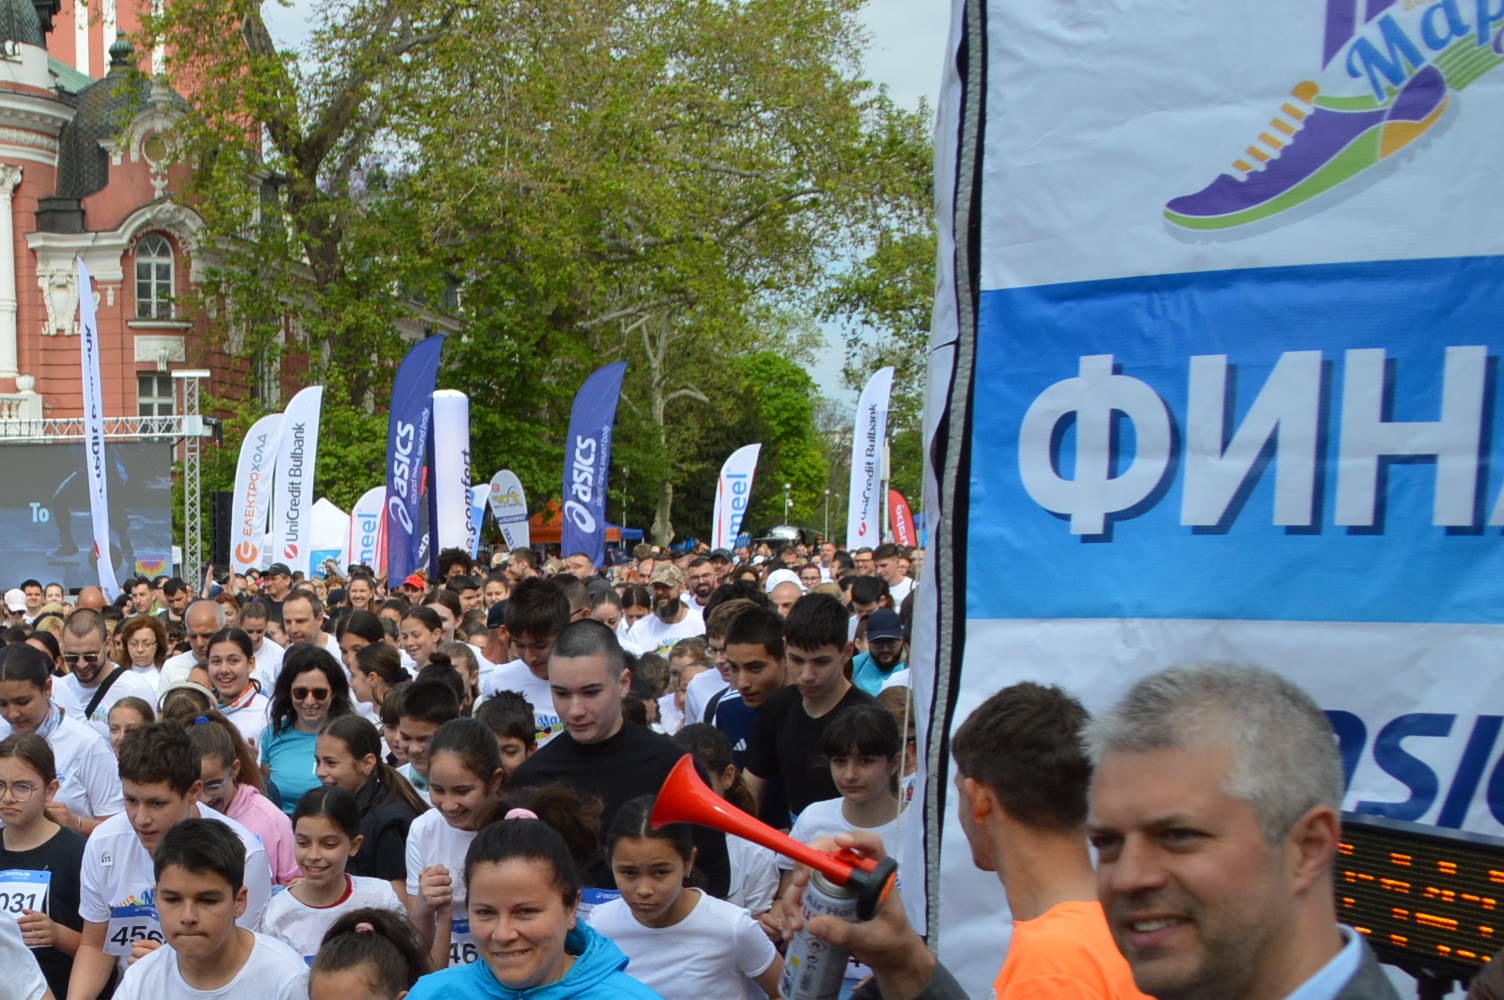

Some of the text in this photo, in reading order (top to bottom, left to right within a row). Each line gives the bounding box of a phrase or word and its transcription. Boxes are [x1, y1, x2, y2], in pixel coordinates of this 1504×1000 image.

[394, 420, 414, 499] asics
[865, 402, 877, 458] Bulbank
[1017, 345, 1504, 536] ФИН
[284, 422, 305, 542] UniCredit Bulbank
[572, 435, 597, 503] asics
[29, 502, 50, 523] To
